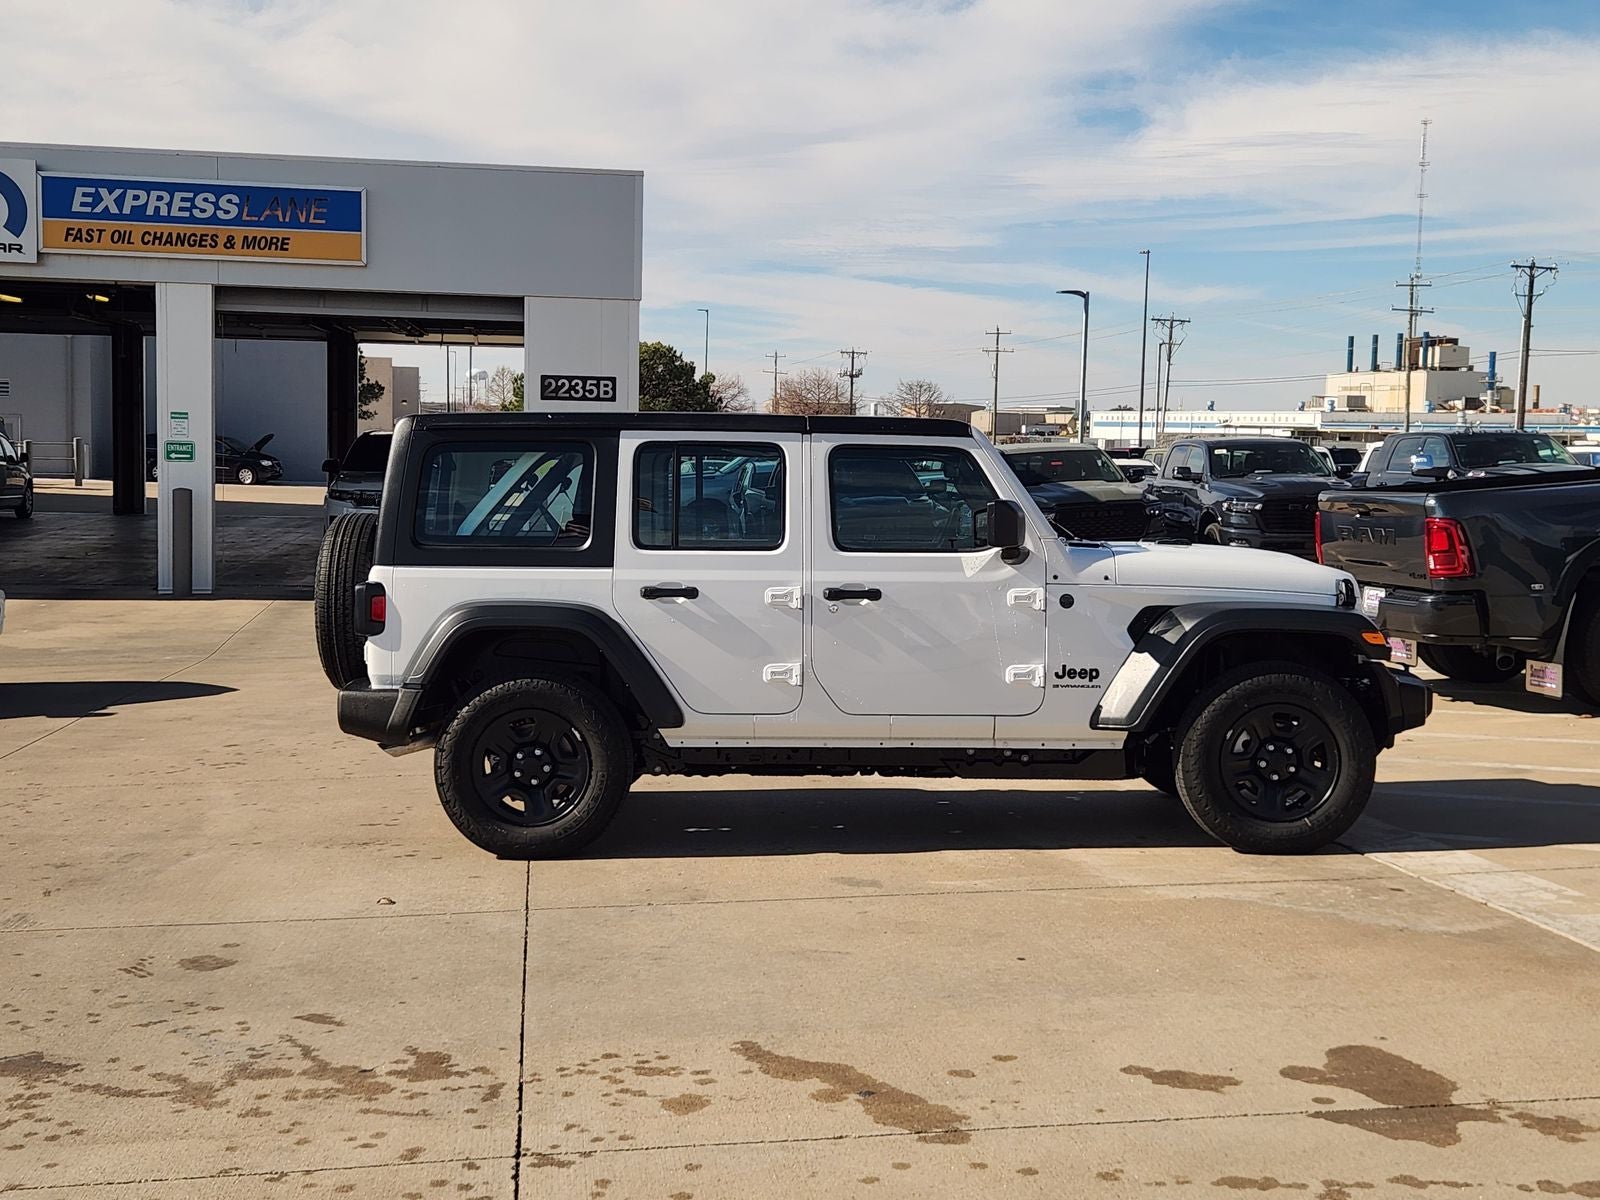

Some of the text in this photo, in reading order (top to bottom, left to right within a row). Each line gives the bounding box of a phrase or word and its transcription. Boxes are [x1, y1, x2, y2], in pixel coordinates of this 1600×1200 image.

[71, 186, 329, 224] EXPRESS LANE
[64, 226, 290, 252] FAST OIL CHANGES & MORE
[544, 378, 613, 398] 2235B
[167, 444, 192, 452] ENTRANCE
[1337, 524, 1397, 546] RAM
[1054, 664, 1100, 682] Jeep
